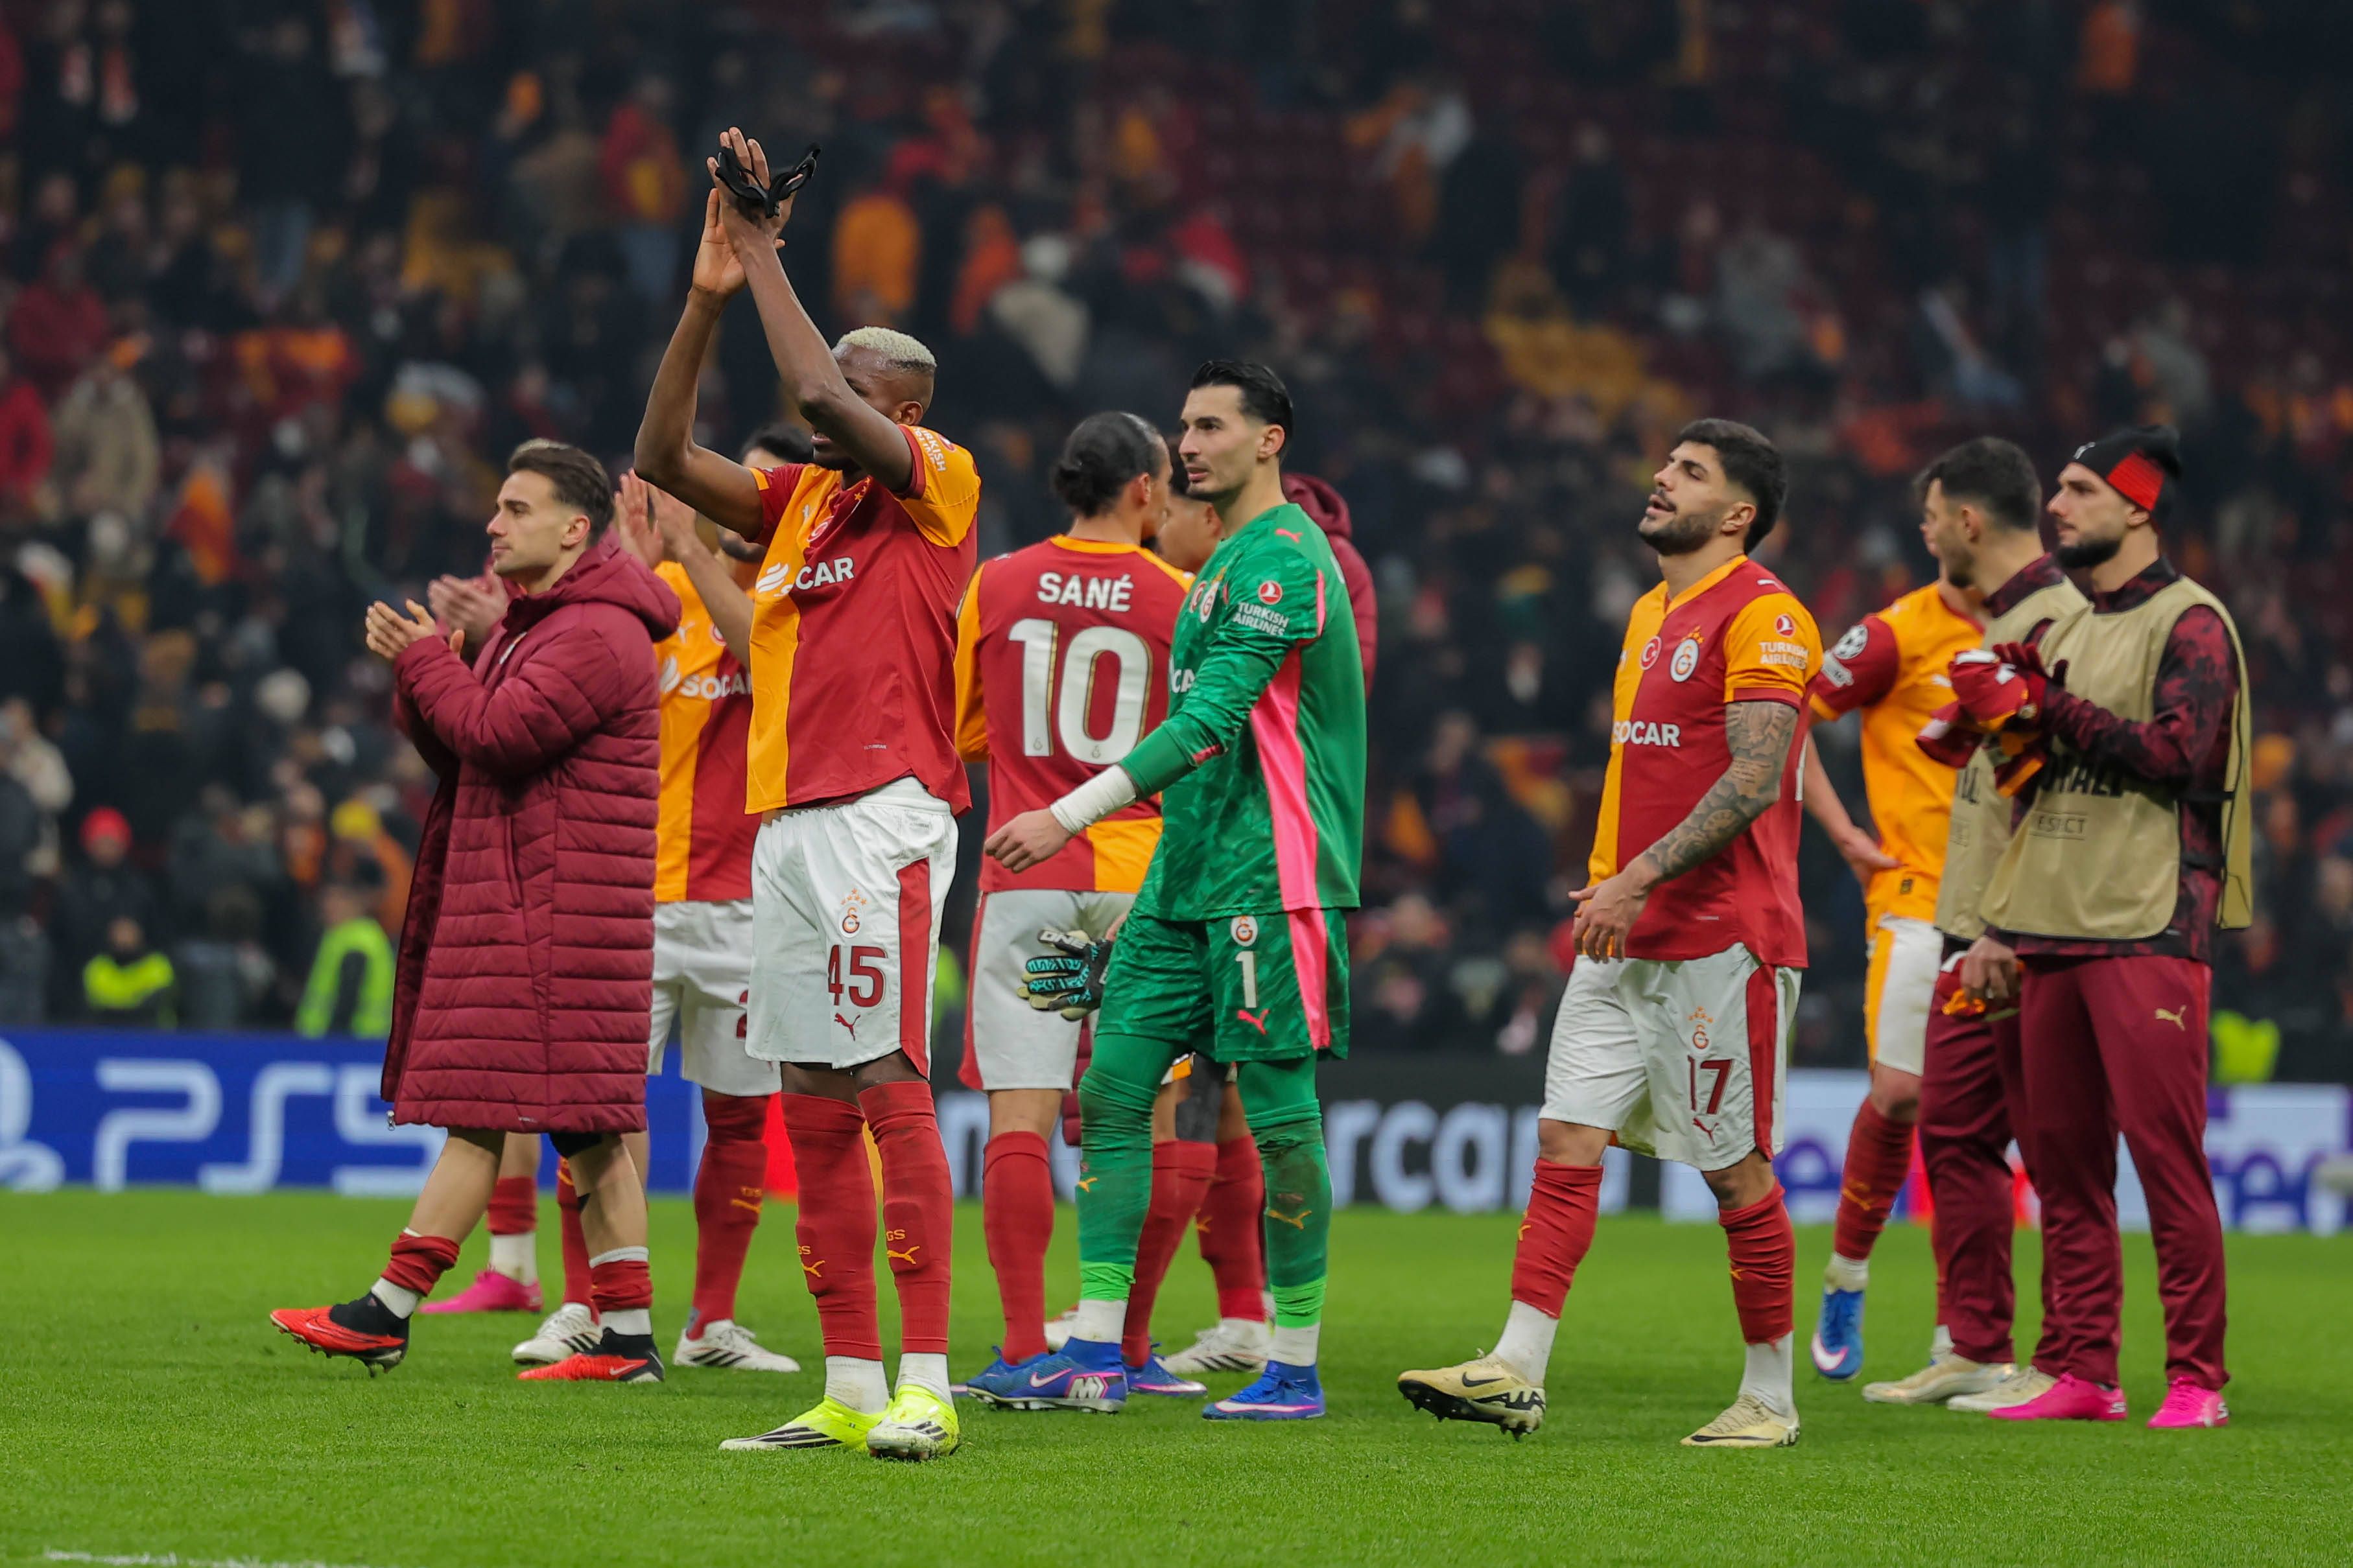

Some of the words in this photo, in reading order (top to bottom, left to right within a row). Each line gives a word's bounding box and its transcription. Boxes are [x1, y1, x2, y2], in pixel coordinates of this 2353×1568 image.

[1037, 571, 1134, 612] SANÉ
[1238, 602, 1290, 629] TURKISH
[1233, 612, 1286, 637] AIRLINES
[679, 672, 753, 701] SOCA
[1008, 617, 1153, 766] 10
[827, 944, 888, 1009] 45
[1235, 950, 1260, 1009] 1
[1686, 1054, 1735, 1116] 17
